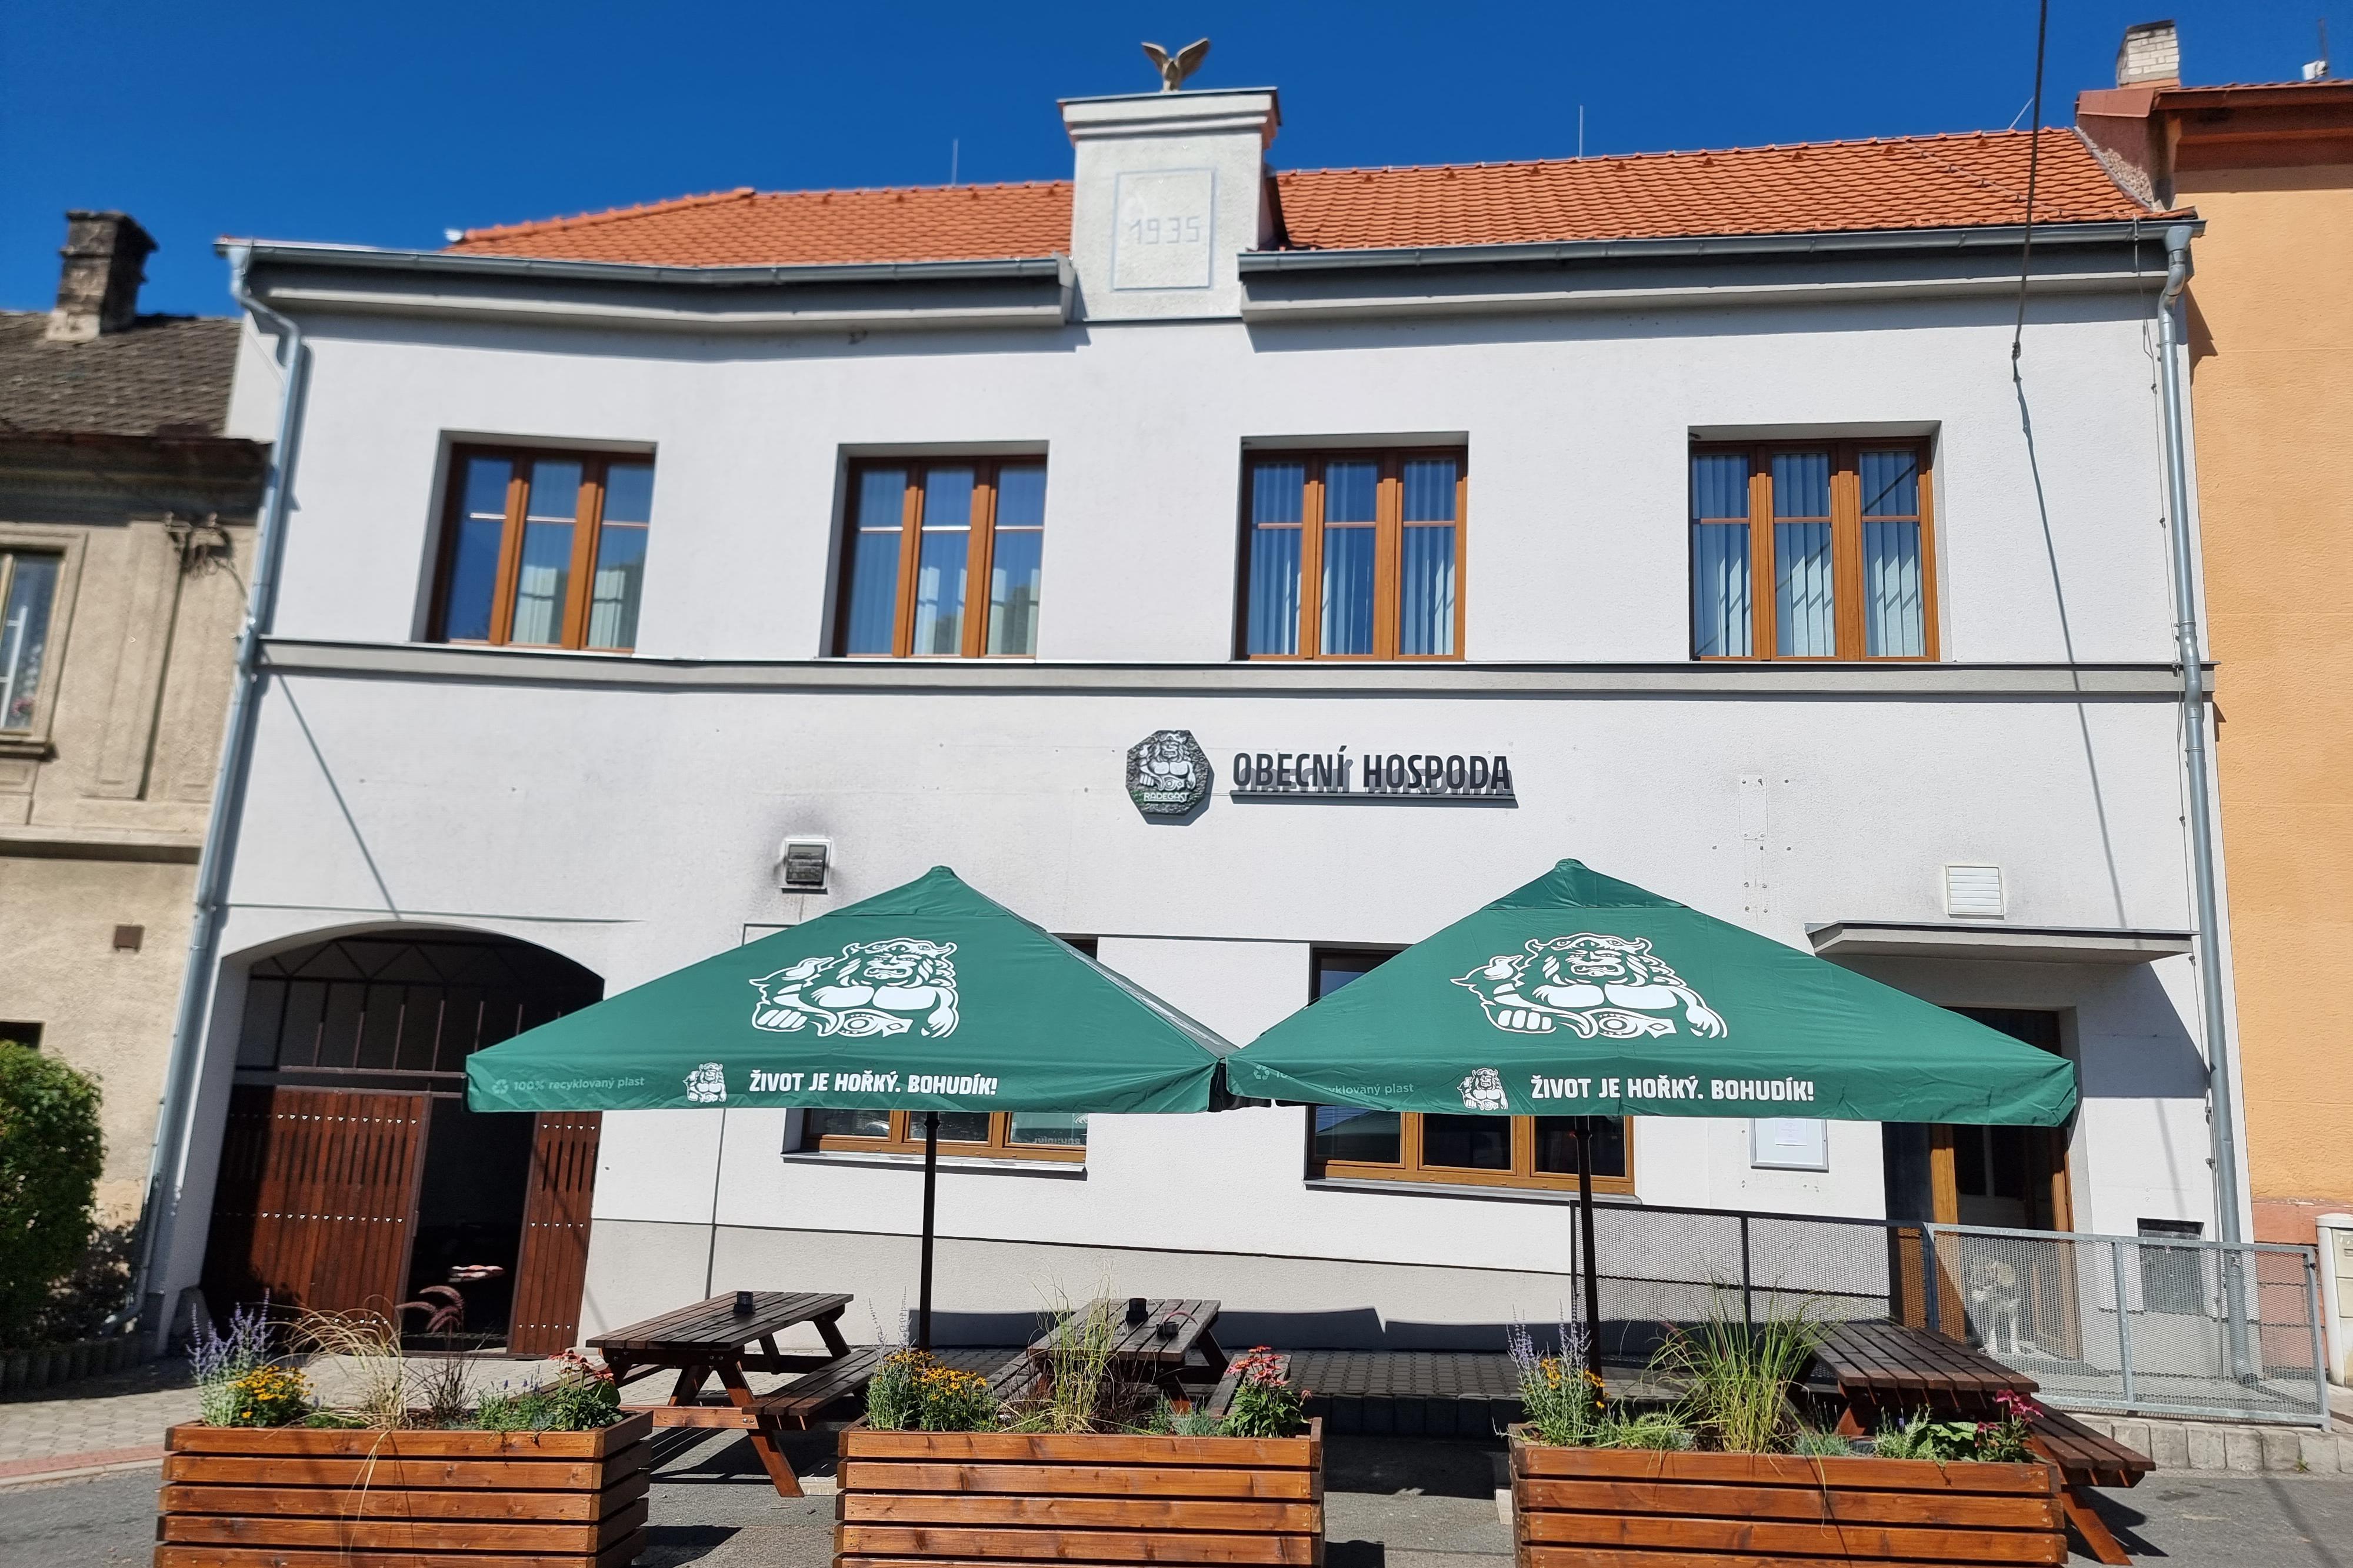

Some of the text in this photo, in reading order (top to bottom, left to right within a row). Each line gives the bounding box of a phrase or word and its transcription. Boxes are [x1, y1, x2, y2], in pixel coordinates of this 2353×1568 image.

[1129, 216, 1201, 244] 1935
[1234, 745, 1511, 789] OBECNÍ HOSPODA
[1143, 792, 1189, 803] RADEGAST
[514, 1076, 645, 1090] 100% recyklovaný plast
[749, 1069, 998, 1095] ŽIVOT JE HOŘKÝ. BOHUDÍK!
[1385, 1083, 1414, 1095] plast
[1531, 1075, 1815, 1102] ŽIVOT JE HOŘKÝ. BOHUDÍK!
